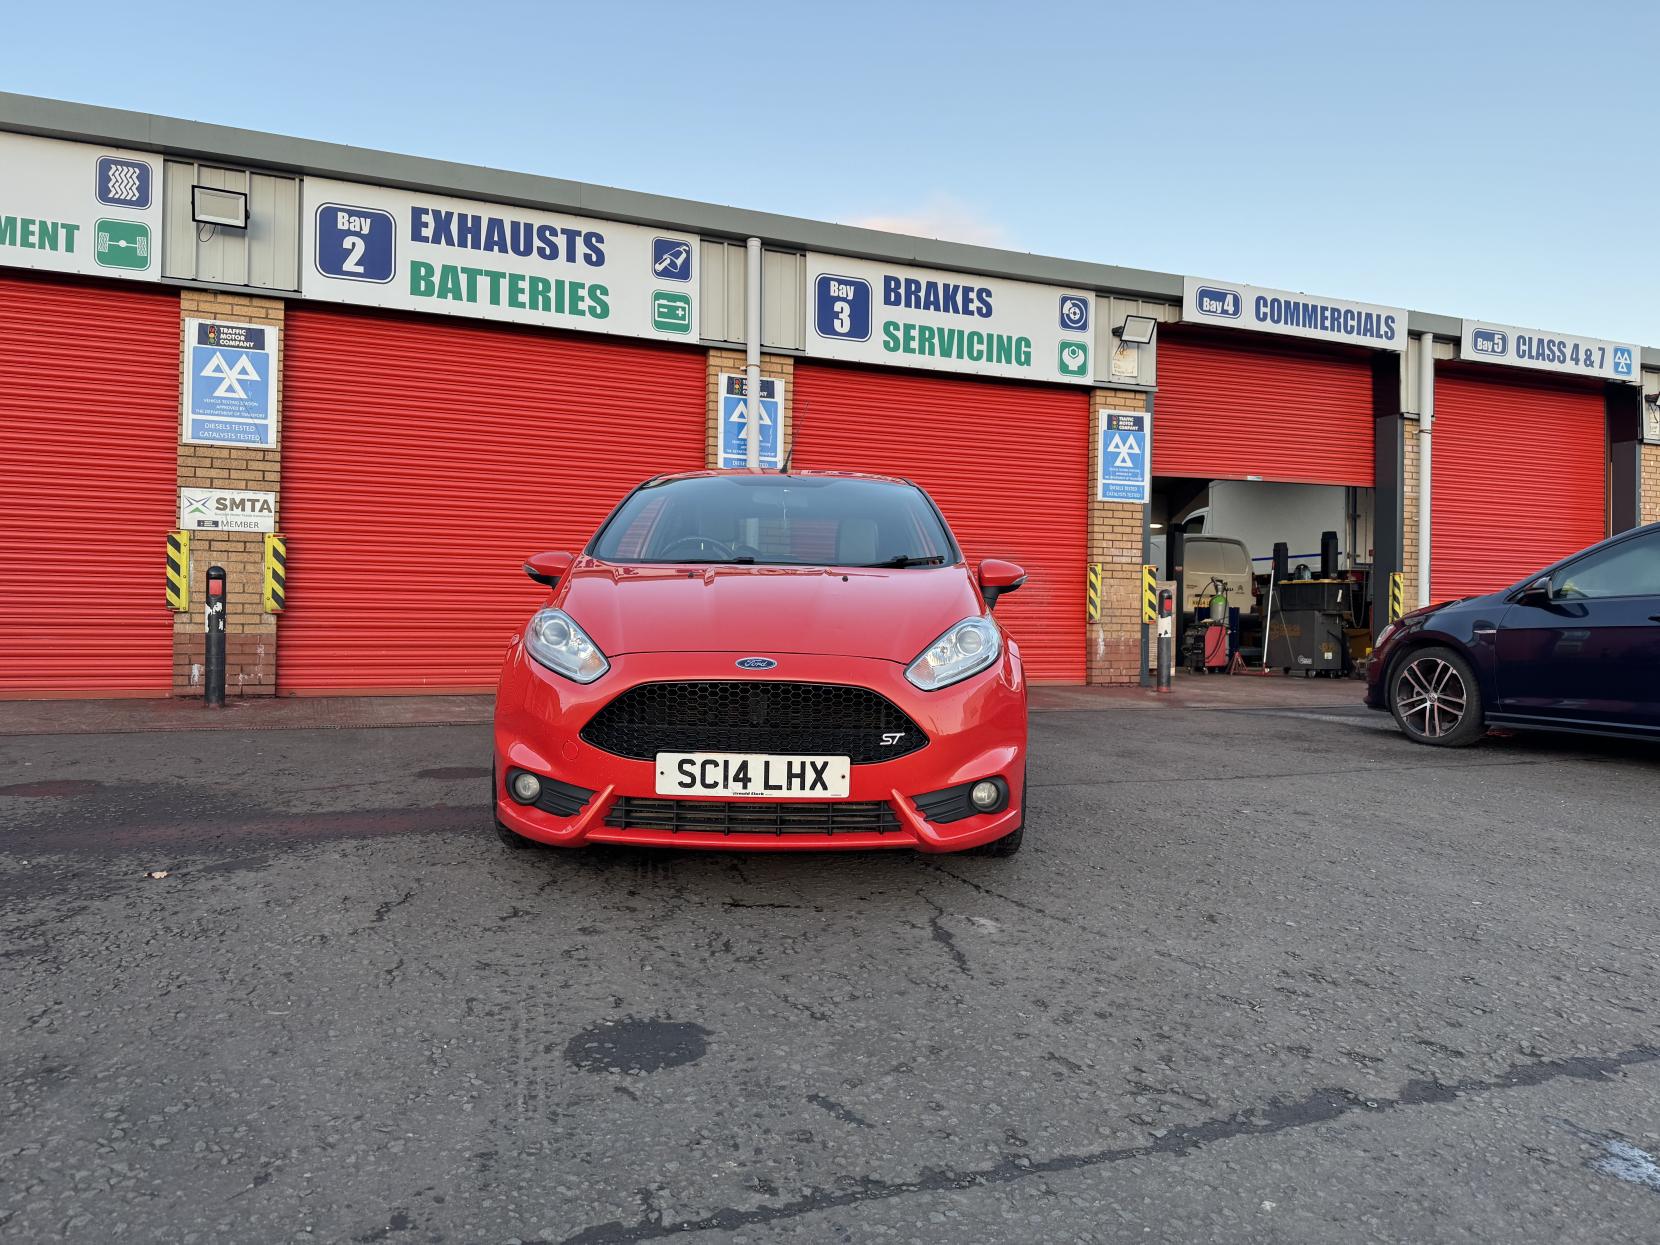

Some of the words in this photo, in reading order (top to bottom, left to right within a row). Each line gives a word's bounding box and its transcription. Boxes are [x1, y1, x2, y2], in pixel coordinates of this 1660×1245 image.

[337, 211, 371, 234] Bay
[0, 215, 80, 254] MENT
[410, 206, 606, 268] EXHAUSTS
[342, 236, 365, 274] 2
[410, 260, 610, 320] BATTERIES
[829, 281, 855, 300] Bay
[883, 274, 993, 319] BRAKES
[1203, 297, 1223, 314] Bay
[1223, 293, 1235, 315] 4
[833, 301, 851, 334] 3
[1254, 295, 1396, 341] COMMERCIALS
[220, 327, 247, 335] TRAFFIC
[220, 333, 246, 341] MOTOR
[220, 339, 255, 348] COMPANY
[882, 320, 1032, 367] SERVICING
[1477, 338, 1492, 352] Bay
[1493, 334, 1503, 353] 5
[1516, 335, 1567, 365] CLASS
[1570, 343, 1580, 366] 4
[1584, 348, 1595, 368] &
[1598, 346, 1606, 369] 7
[199, 431, 236, 439] CATALYSTS
[237, 433, 261, 441] TESTED
[204, 422, 231, 430] DIESELS
[231, 424, 257, 432] TESTED
[215, 497, 273, 513] SMTA
[220, 520, 260, 529] MEMBER
[879, 732, 905, 746] ST
[677, 758, 752, 790] SC14
[763, 760, 829, 791] LHX
